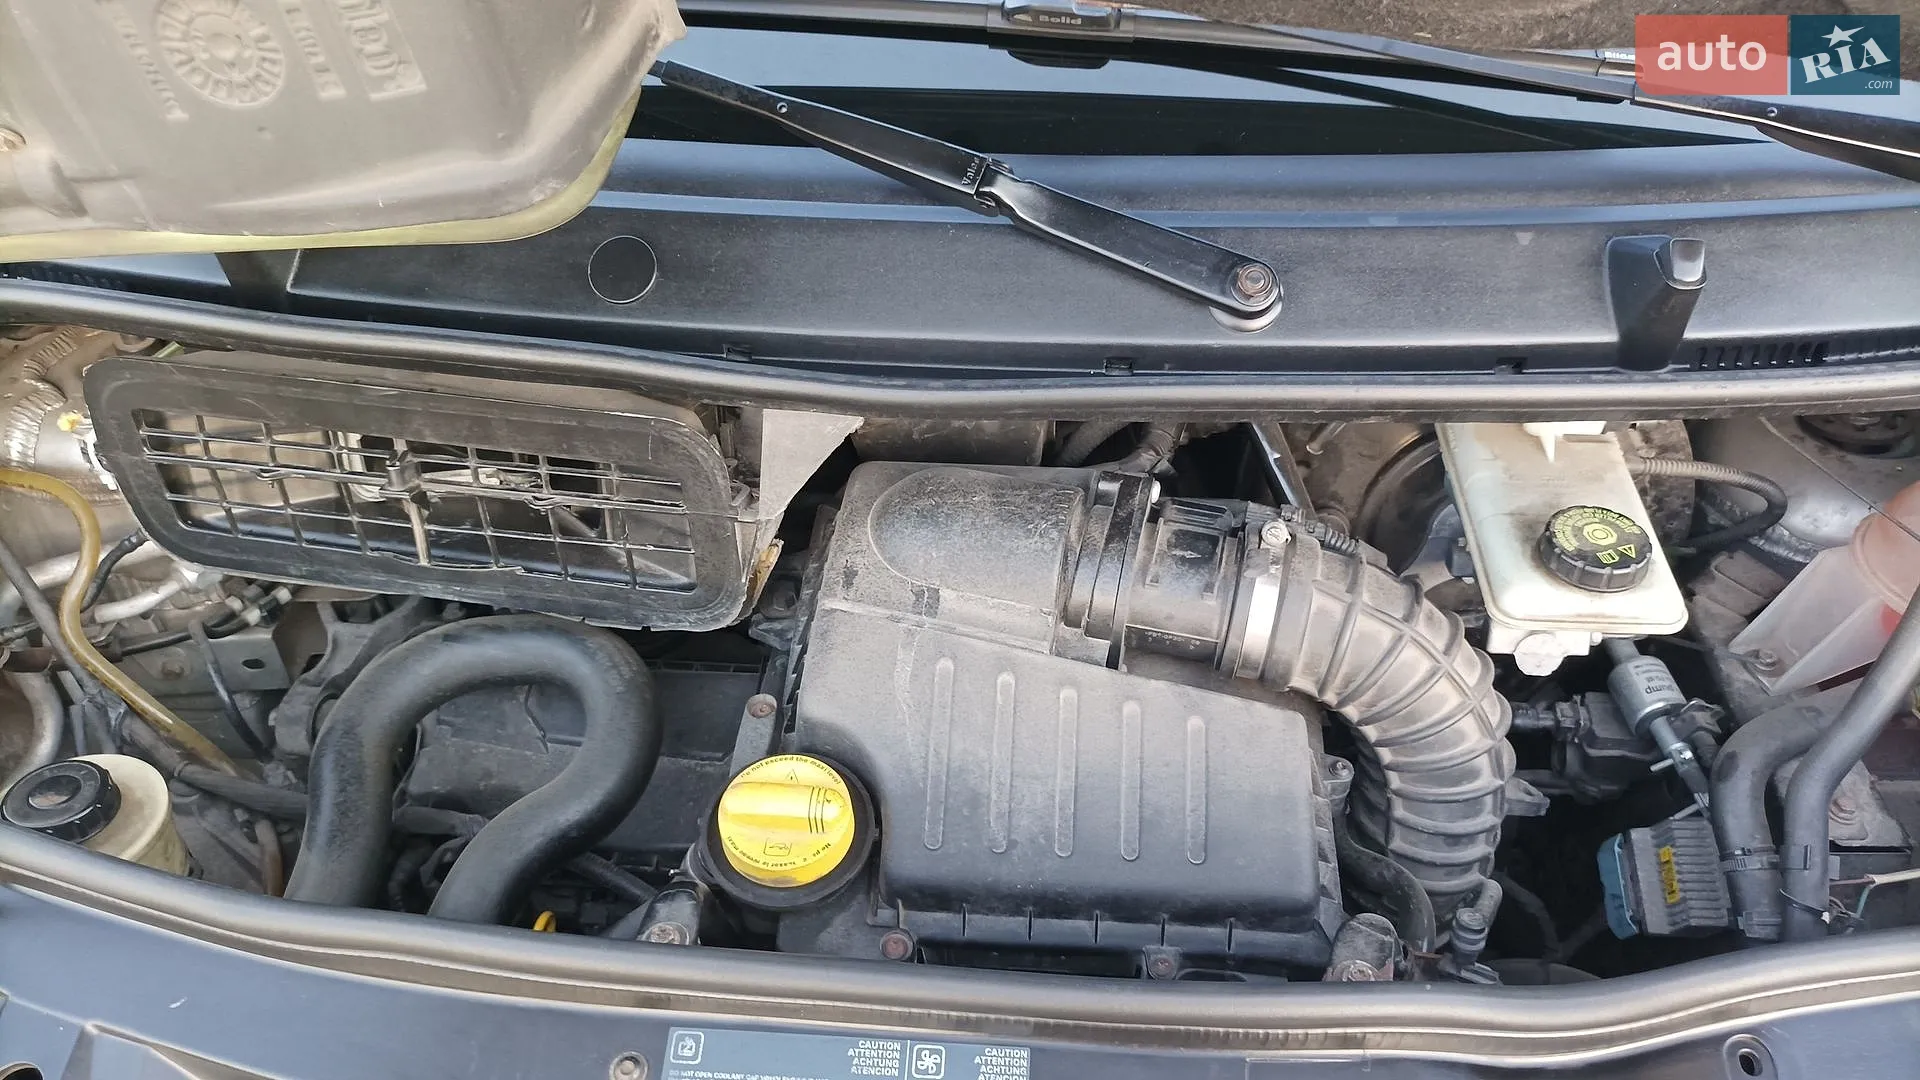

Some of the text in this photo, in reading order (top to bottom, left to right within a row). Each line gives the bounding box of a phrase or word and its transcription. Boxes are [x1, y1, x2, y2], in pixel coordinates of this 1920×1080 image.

[795, 756, 808, 764] the
[858, 1040, 901, 1051] CAUTION
[847, 1048, 900, 1059] ATTENTION
[984, 1047, 1028, 1058] CAUTION
[852, 1057, 900, 1068] ACHTUNG
[974, 1056, 1028, 1067] ATTENTION
[695, 1071, 713, 1079] OPEN
[850, 1066, 899, 1077] ATENCION
[979, 1065, 1027, 1076] ACHTUNG
